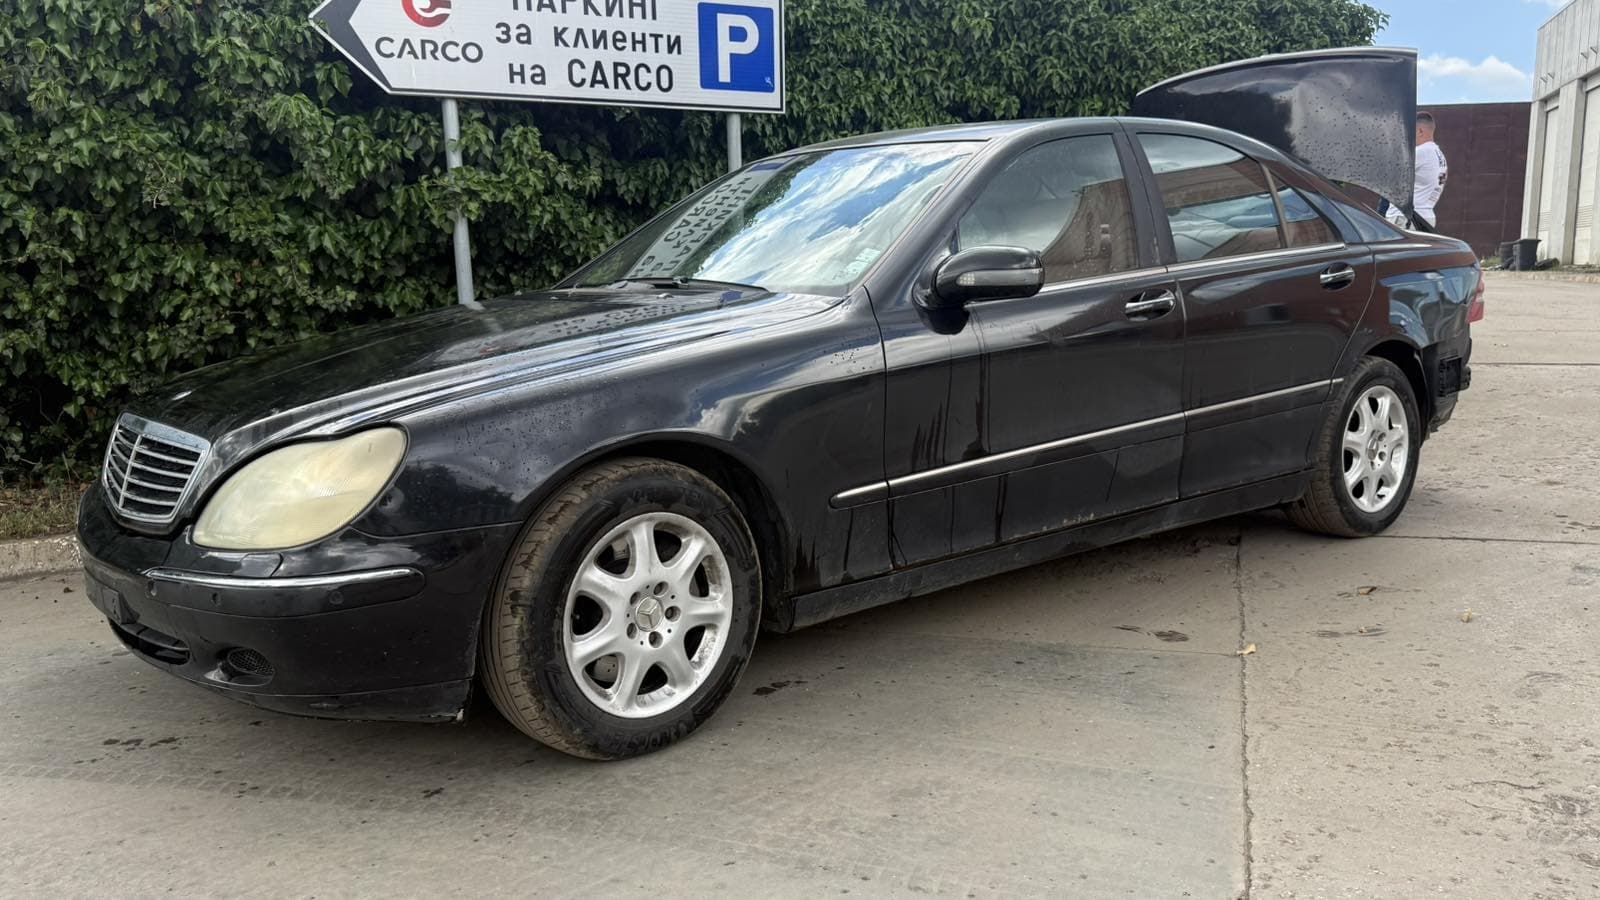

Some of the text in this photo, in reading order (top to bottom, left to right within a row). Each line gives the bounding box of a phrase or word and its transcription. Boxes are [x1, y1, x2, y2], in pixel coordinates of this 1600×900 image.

[375, 36, 484, 63] CARCO
[495, 22, 682, 55] за клиенти
[716, 12, 760, 83] P
[508, 58, 674, 93] на CARCO
